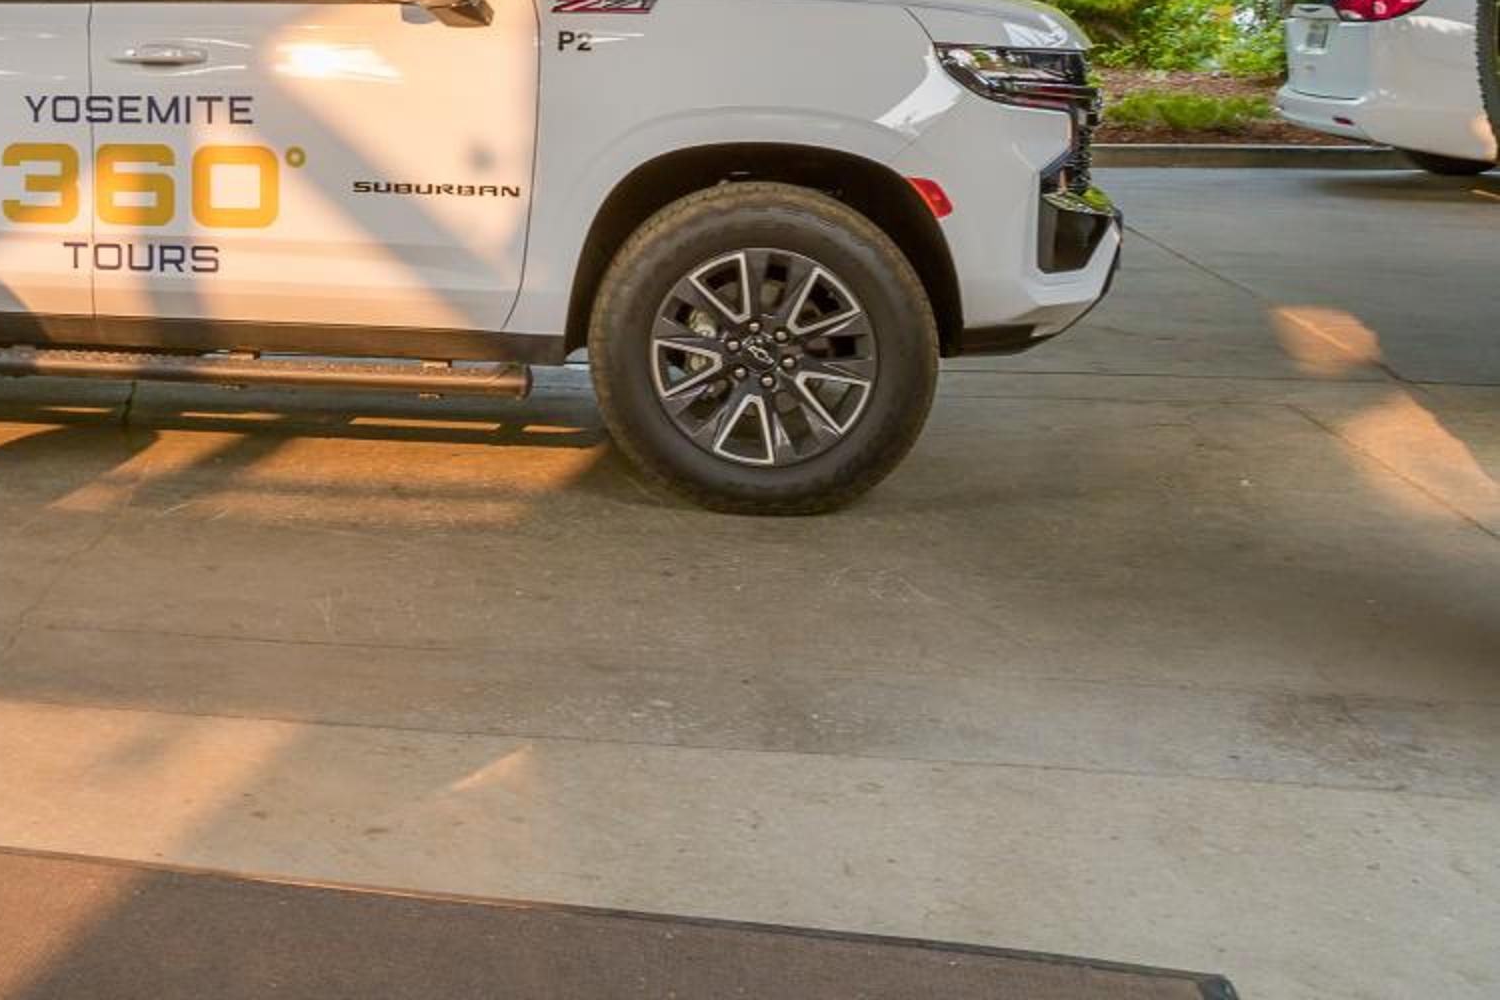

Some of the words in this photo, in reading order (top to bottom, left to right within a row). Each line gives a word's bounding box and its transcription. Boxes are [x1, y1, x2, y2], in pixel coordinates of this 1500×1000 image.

[558, 30, 592, 51] P2
[25, 96, 253, 124] YOSEMITE
[352, 181, 520, 198] SUBURBAN
[63, 242, 219, 272] TOURS
